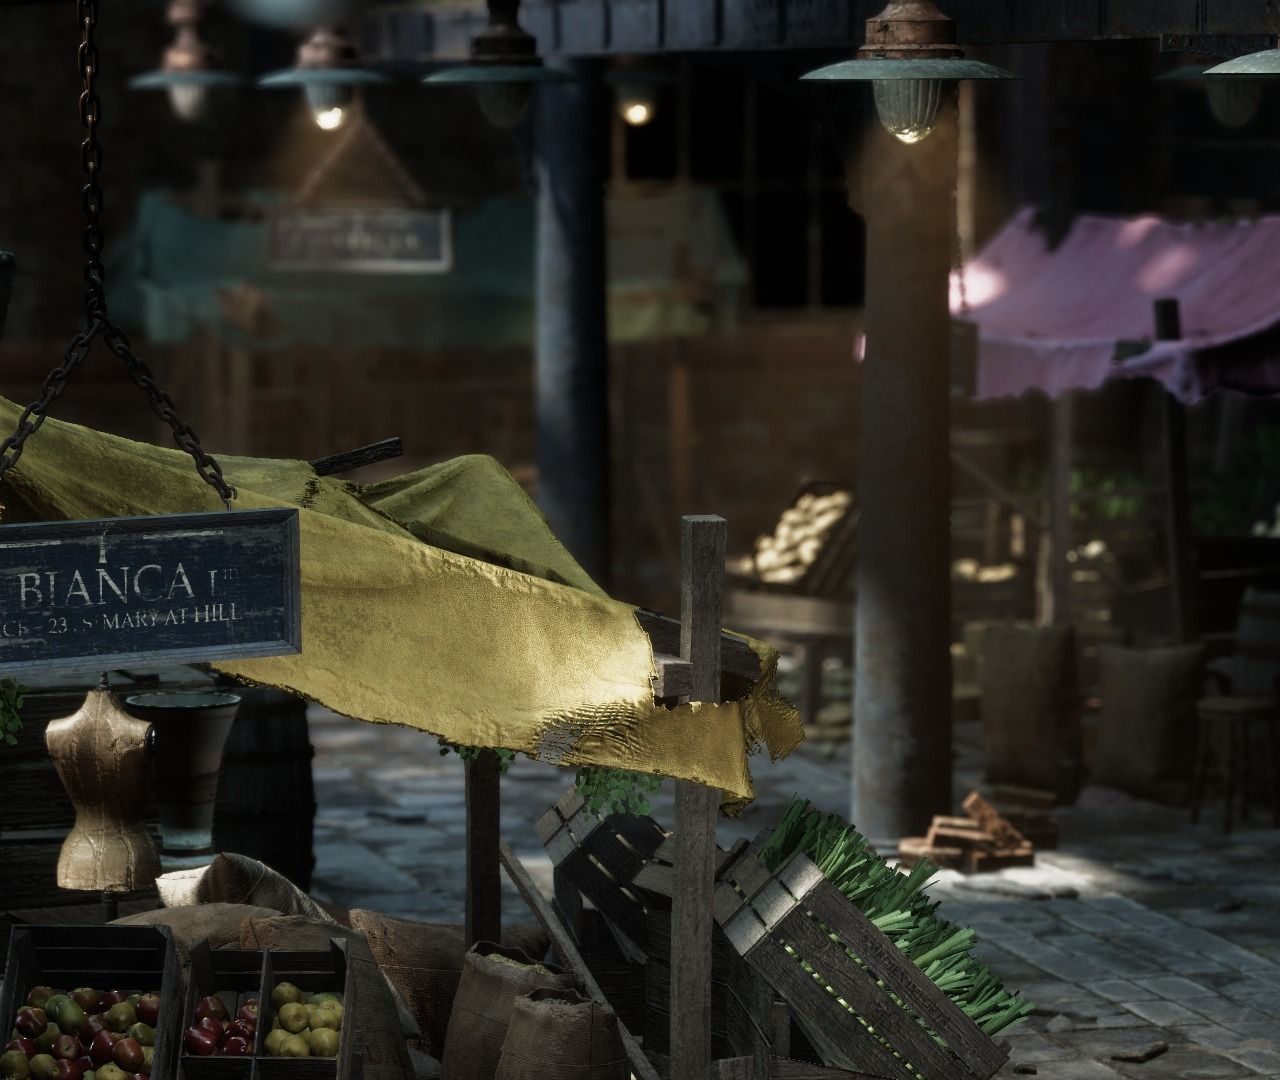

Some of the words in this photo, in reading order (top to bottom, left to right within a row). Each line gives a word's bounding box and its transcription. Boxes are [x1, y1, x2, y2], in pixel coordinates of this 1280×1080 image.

[18, 562, 195, 611] BIANCA
[103, 607, 158, 631] MARY
[164, 605, 187, 626] AT
[194, 601, 244, 623] HILL
